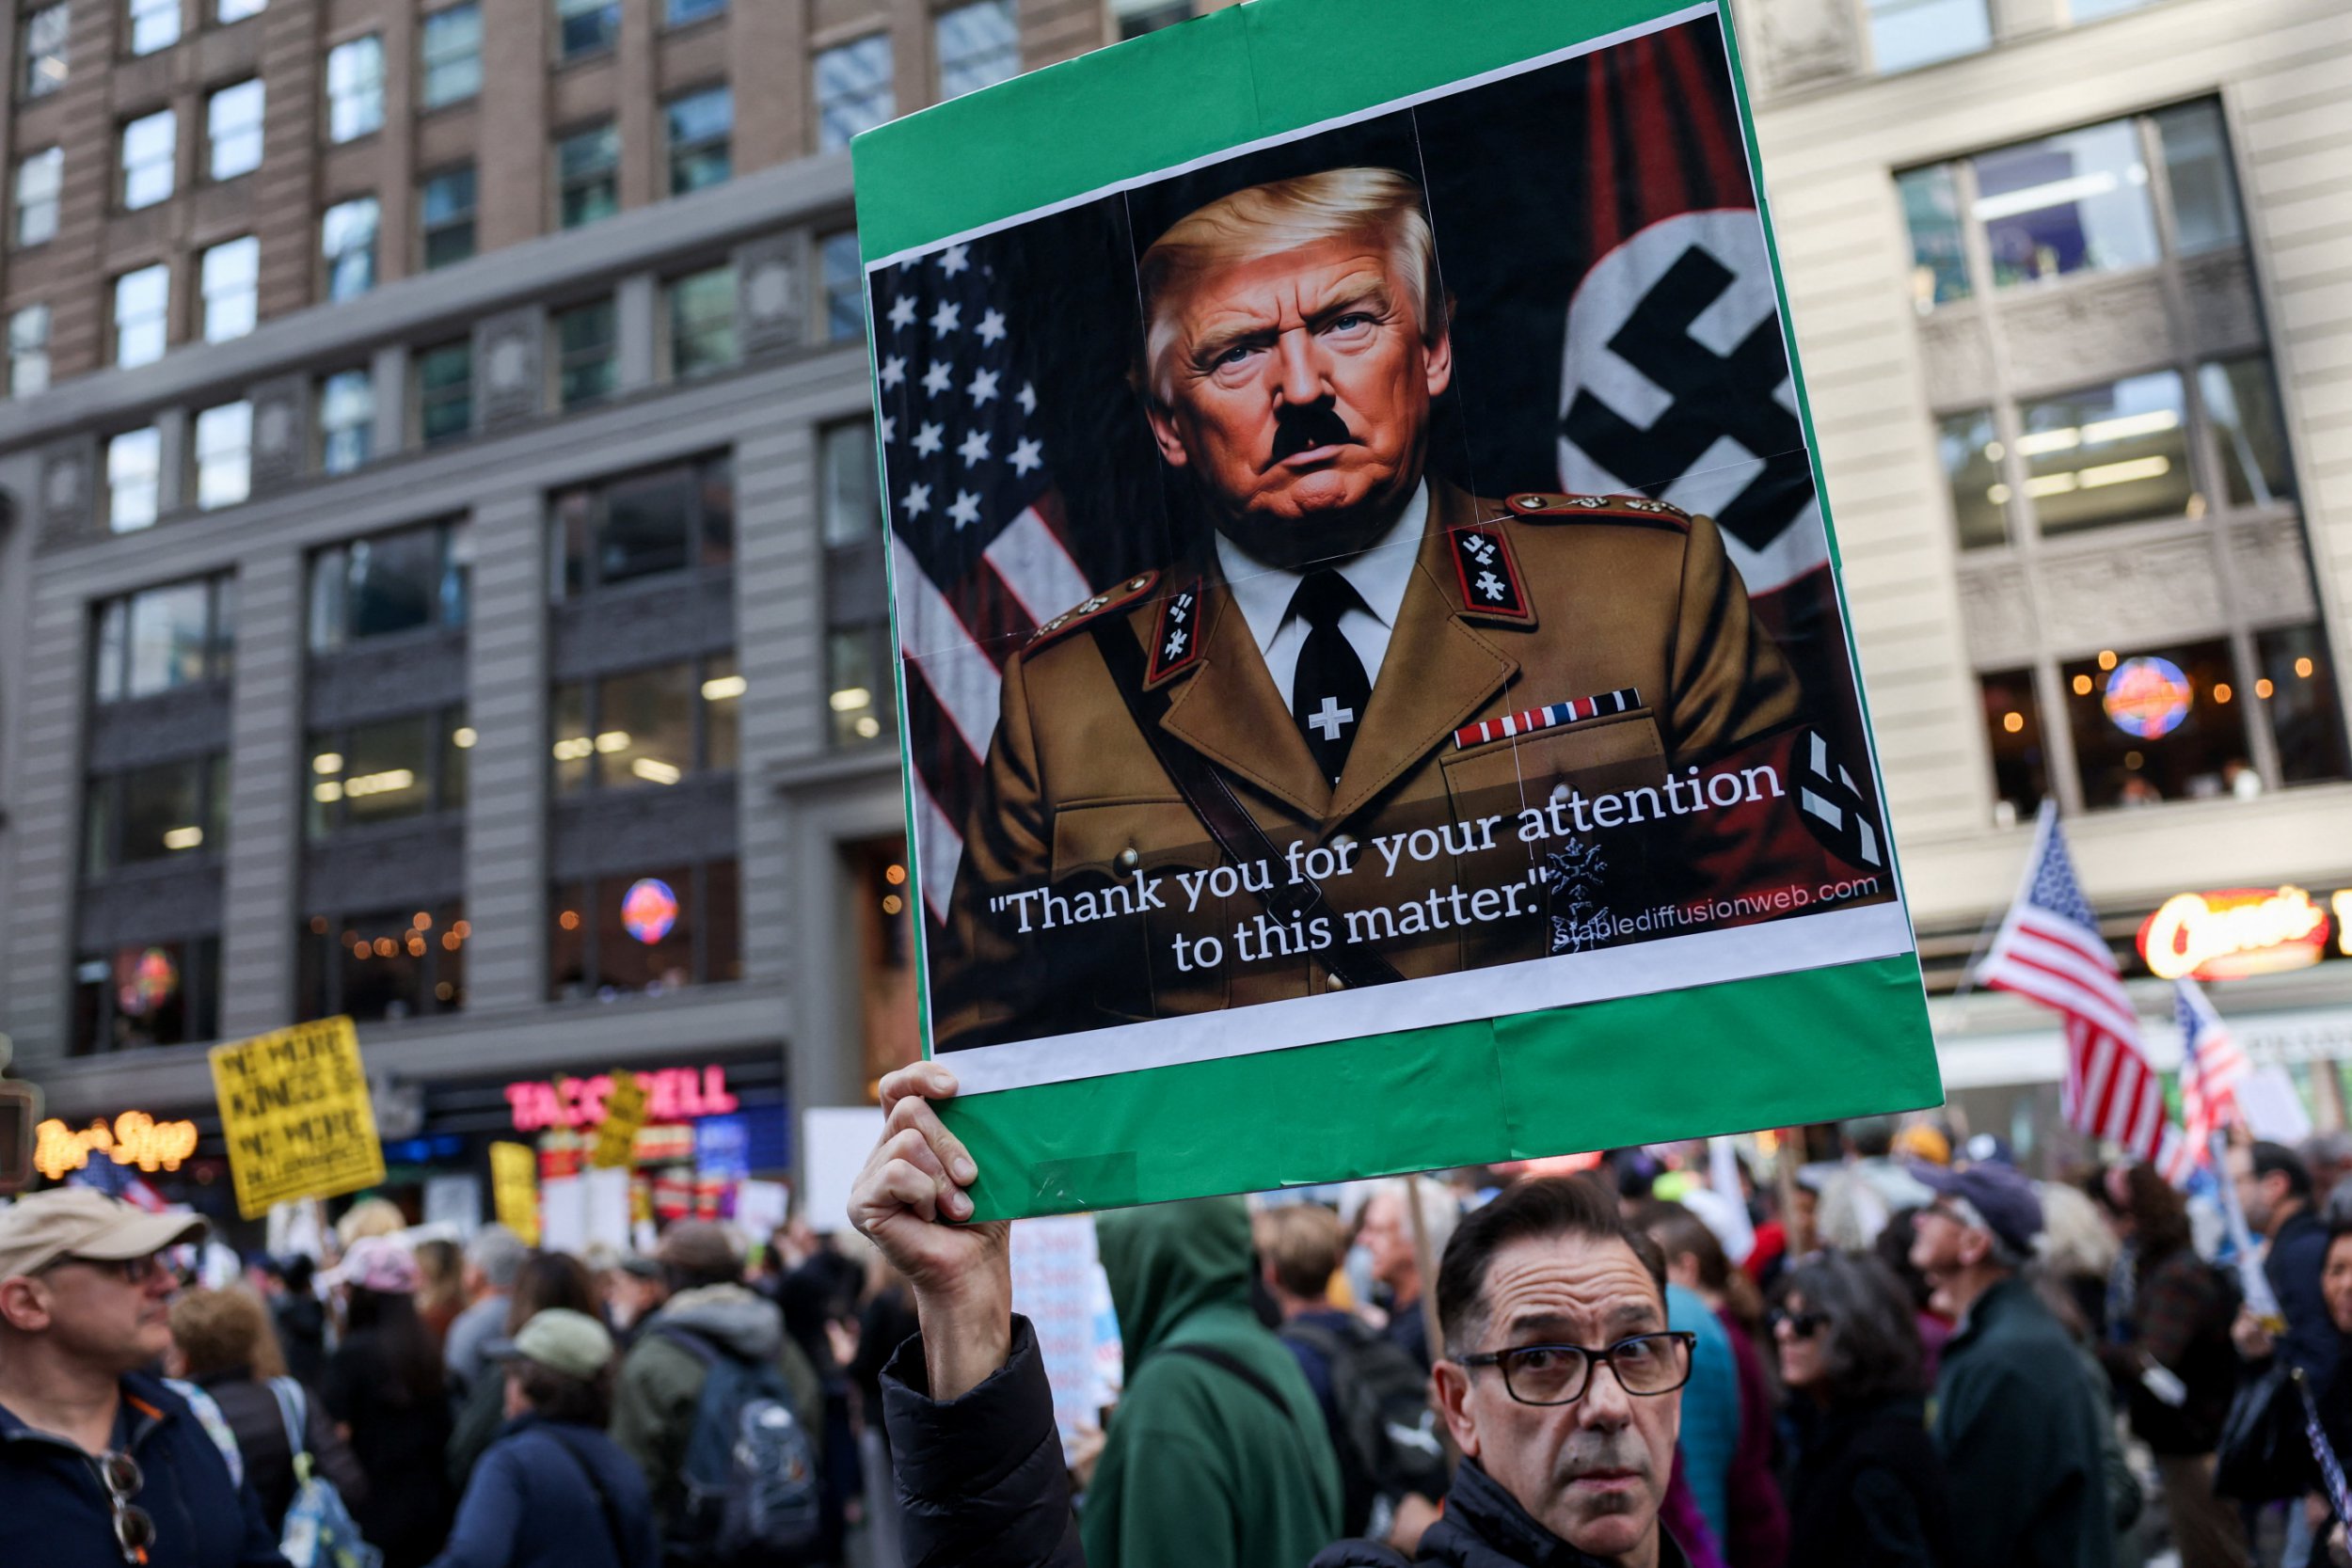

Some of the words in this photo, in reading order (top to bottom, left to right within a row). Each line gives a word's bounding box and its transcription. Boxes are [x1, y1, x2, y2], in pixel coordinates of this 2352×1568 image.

[990, 869, 1167, 933] "Thank
[1176, 856, 1274, 912] you
[1283, 839, 1364, 885] for
[1372, 812, 1502, 878] your
[1517, 763, 1786, 843] attention
[1172, 931, 1224, 972] to
[1233, 911, 1333, 960] this
[1343, 867, 1549, 943] matter."
[1554, 876, 1880, 943] stablediffusionweb.com
